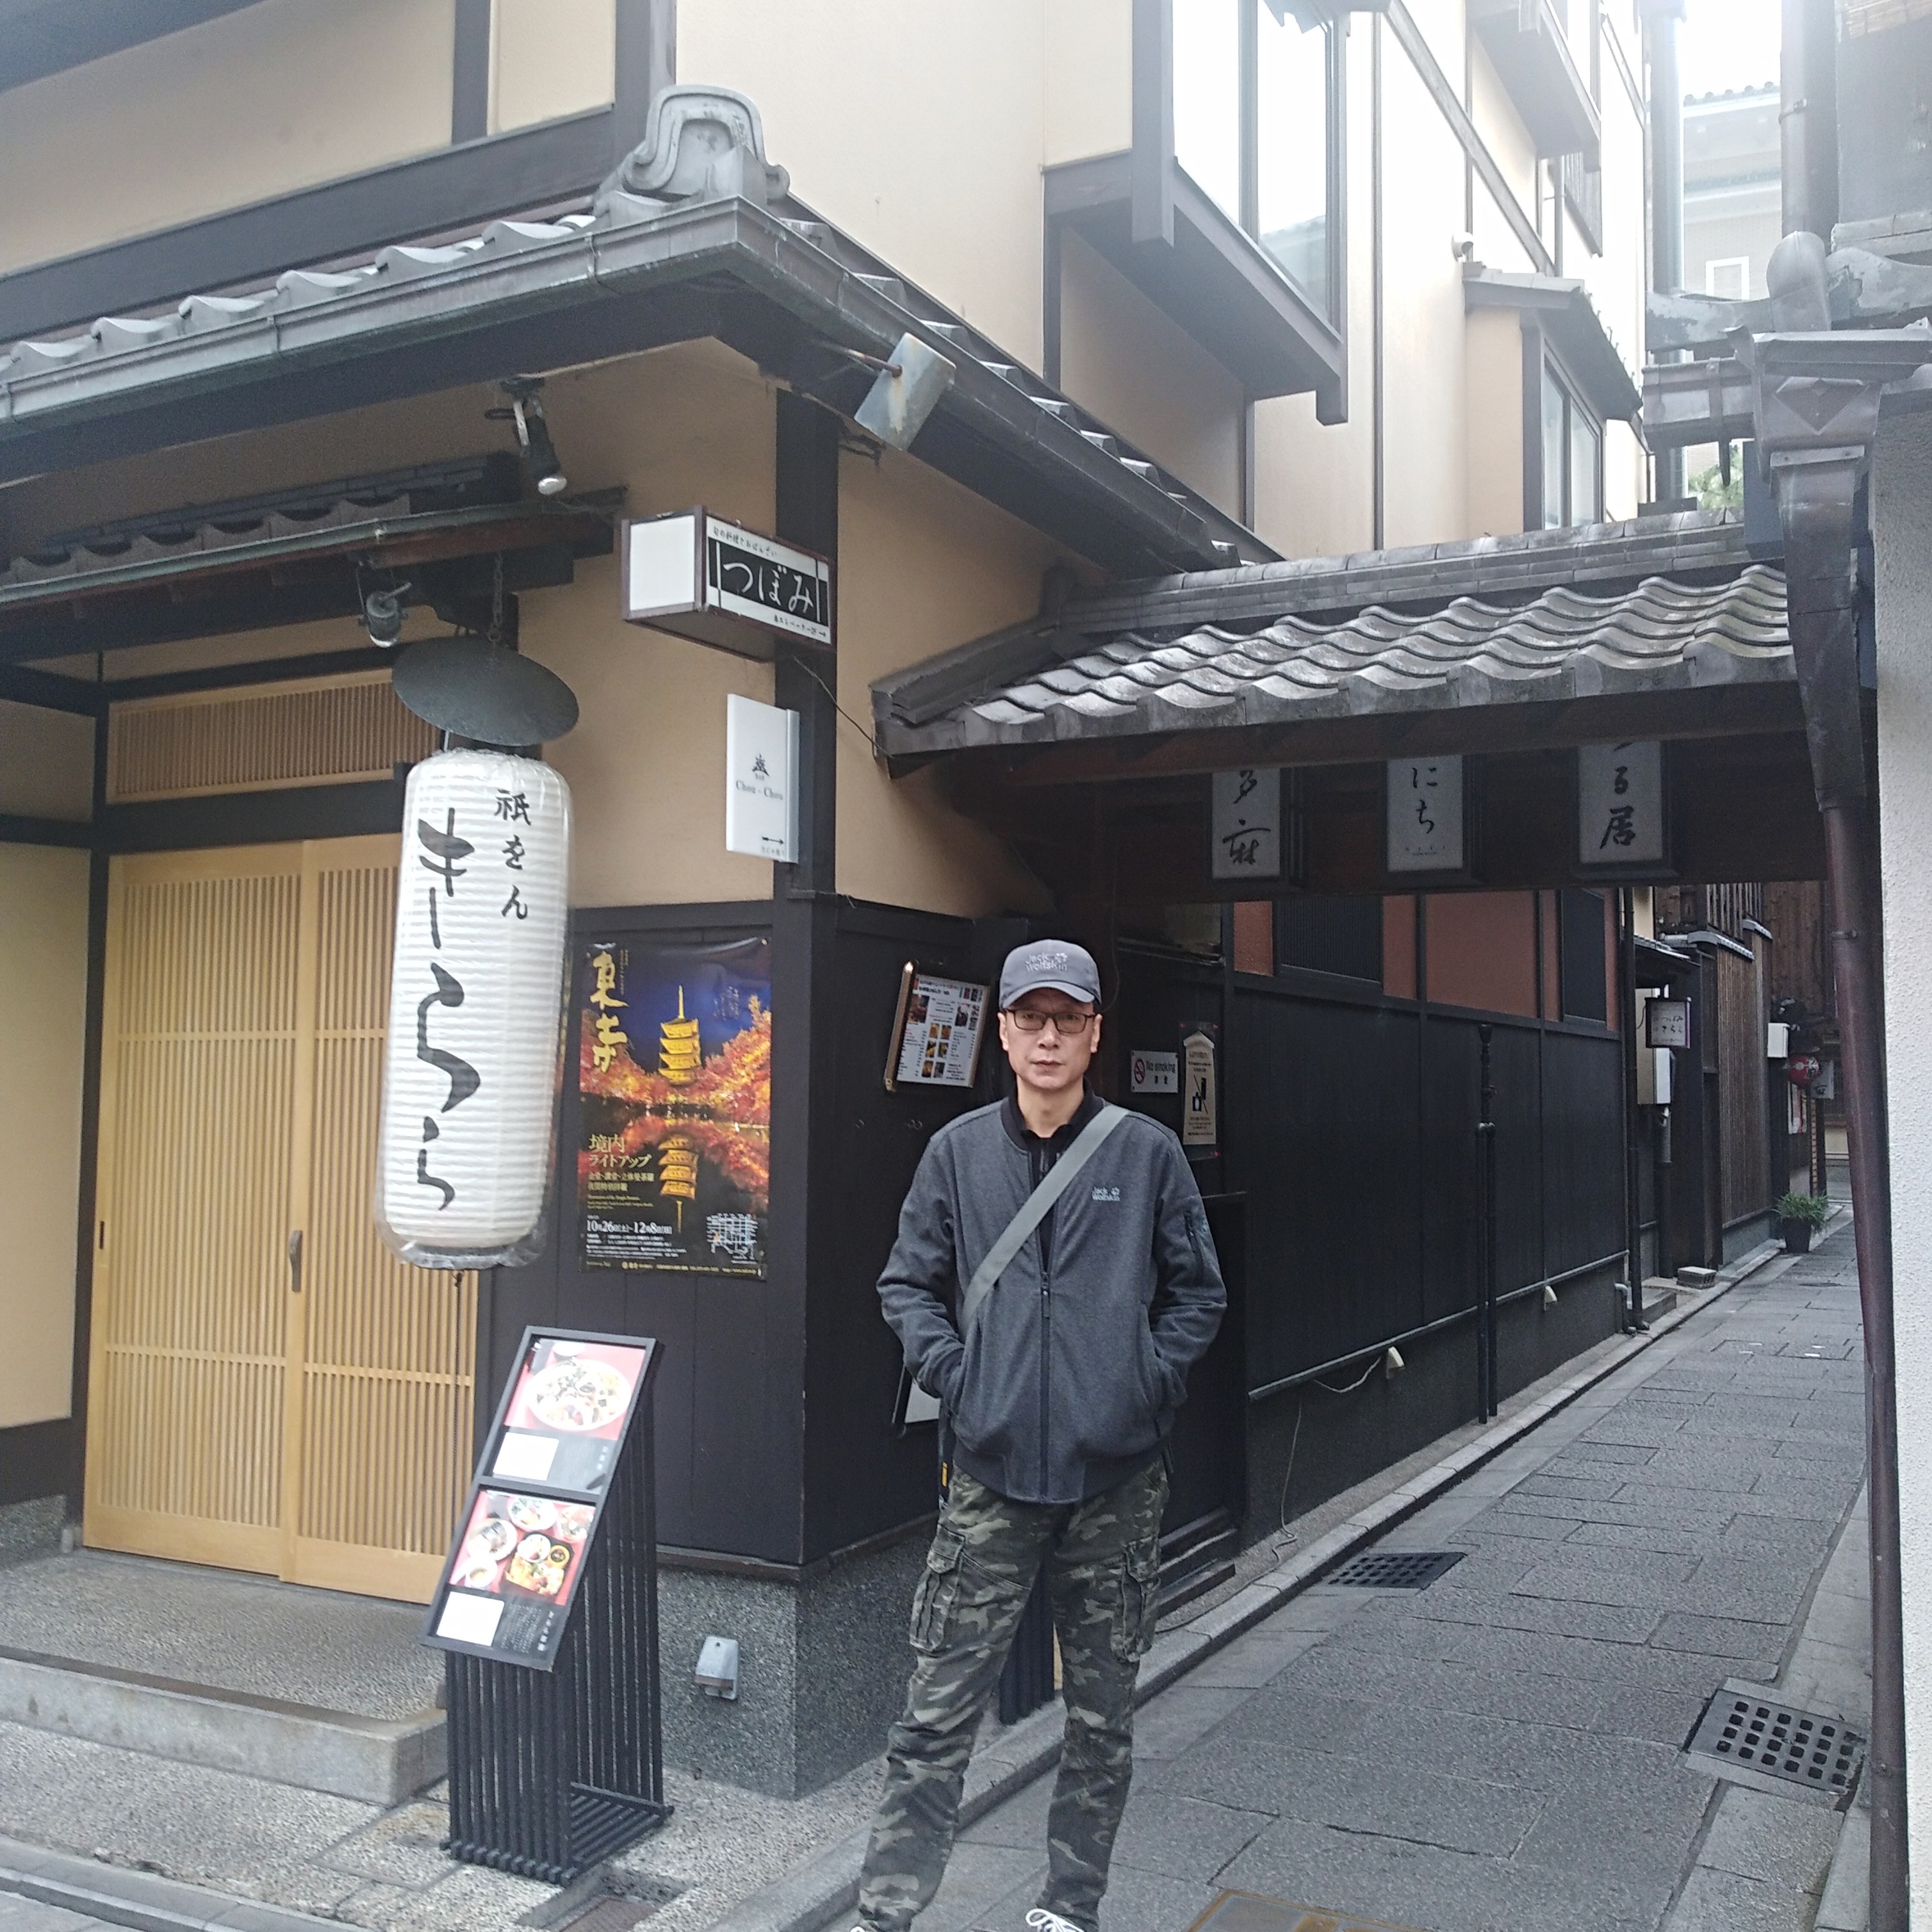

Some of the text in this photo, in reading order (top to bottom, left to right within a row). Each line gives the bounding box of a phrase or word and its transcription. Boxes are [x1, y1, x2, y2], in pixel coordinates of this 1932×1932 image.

[723, 564, 815, 614] つぼみ
[1412, 767, 1438, 835] にち
[1600, 742, 1636, 849] る居
[493, 788, 531, 921] 祇をん
[1025, 960, 1068, 972] Wolfskin
[589, 950, 629, 1074] 東寺
[1146, 1060, 1154, 1071] No
[1154, 1061, 1175, 1074] smoking
[588, 1133, 625, 1153] 境内
[588, 1153, 653, 1169] ライトアップ
